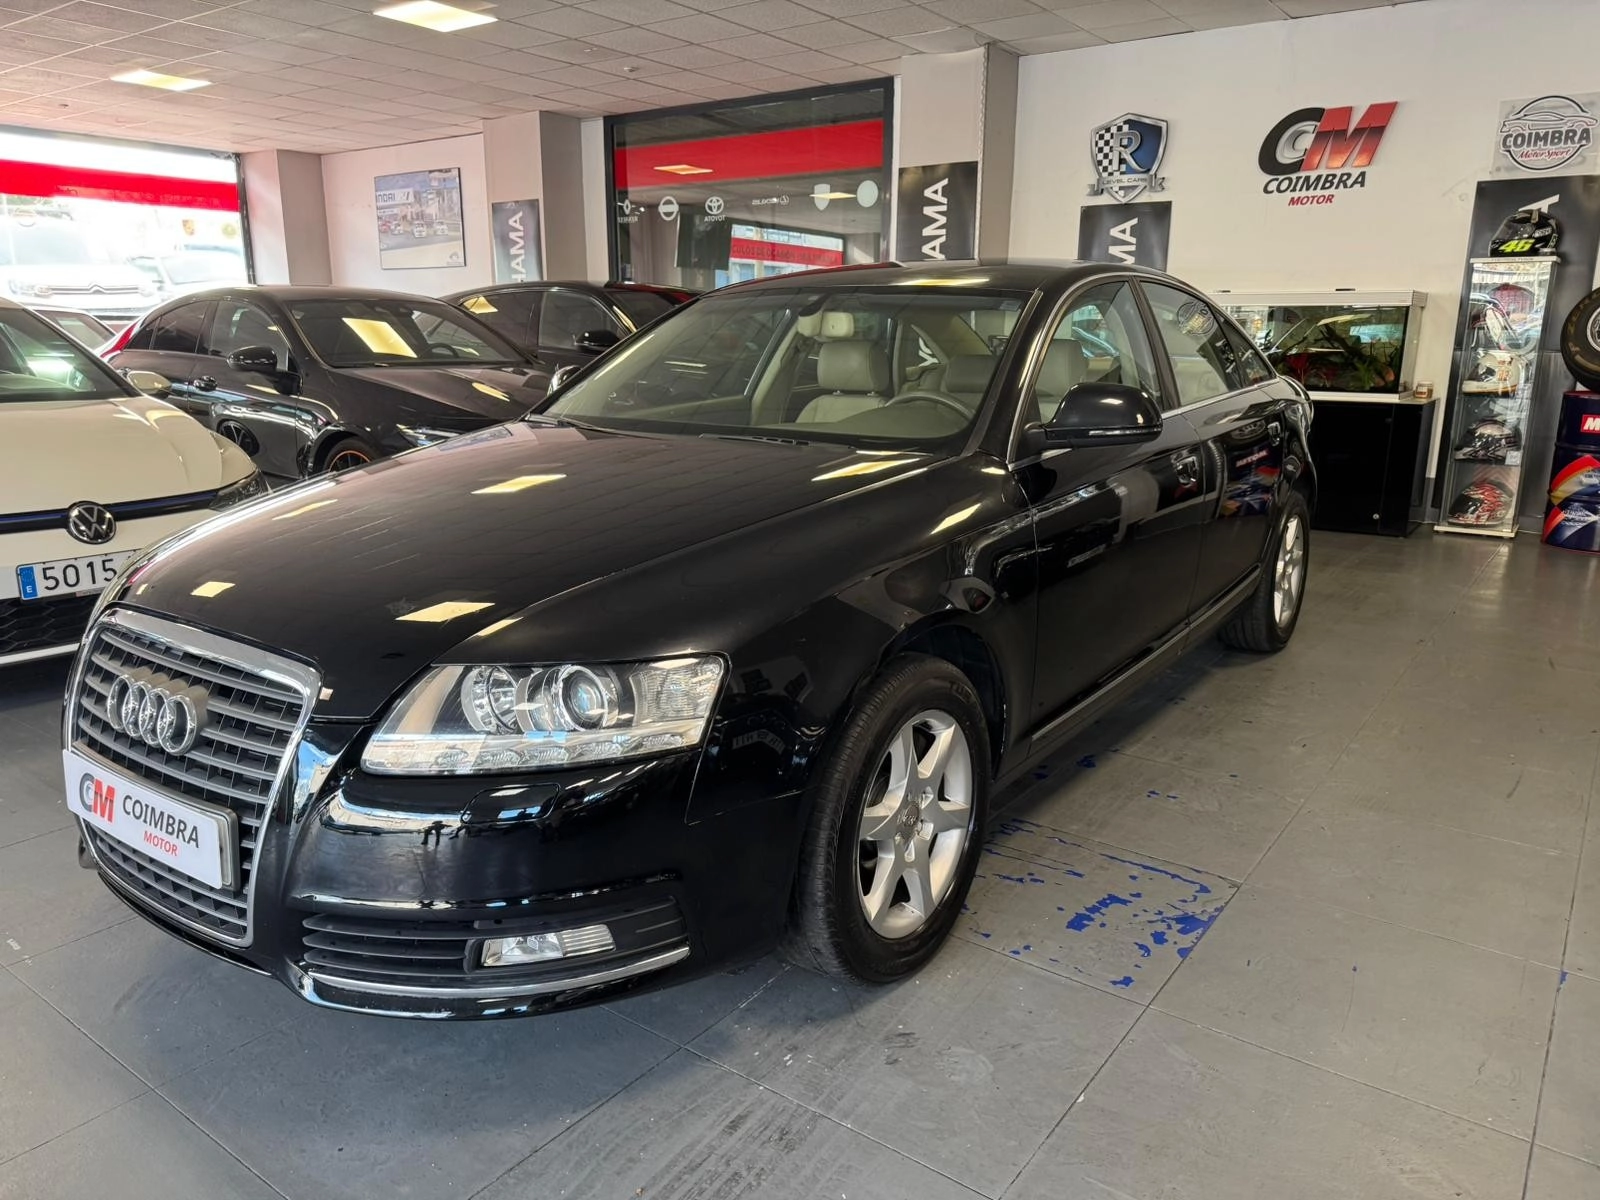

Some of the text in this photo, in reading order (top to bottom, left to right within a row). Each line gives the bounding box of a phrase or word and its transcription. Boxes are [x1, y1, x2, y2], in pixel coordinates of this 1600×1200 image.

[1502, 127, 1591, 149] COIMBRA
[1112, 130, 1151, 171] R
[1263, 171, 1366, 194] COIMBRA
[376, 192, 396, 203] NDAI
[1288, 194, 1335, 206] MOTOR
[1498, 239, 1536, 253] 46
[26, 558, 118, 593] E 5015
[122, 794, 200, 848] COIMBRA
[143, 830, 178, 857] MOTOR
